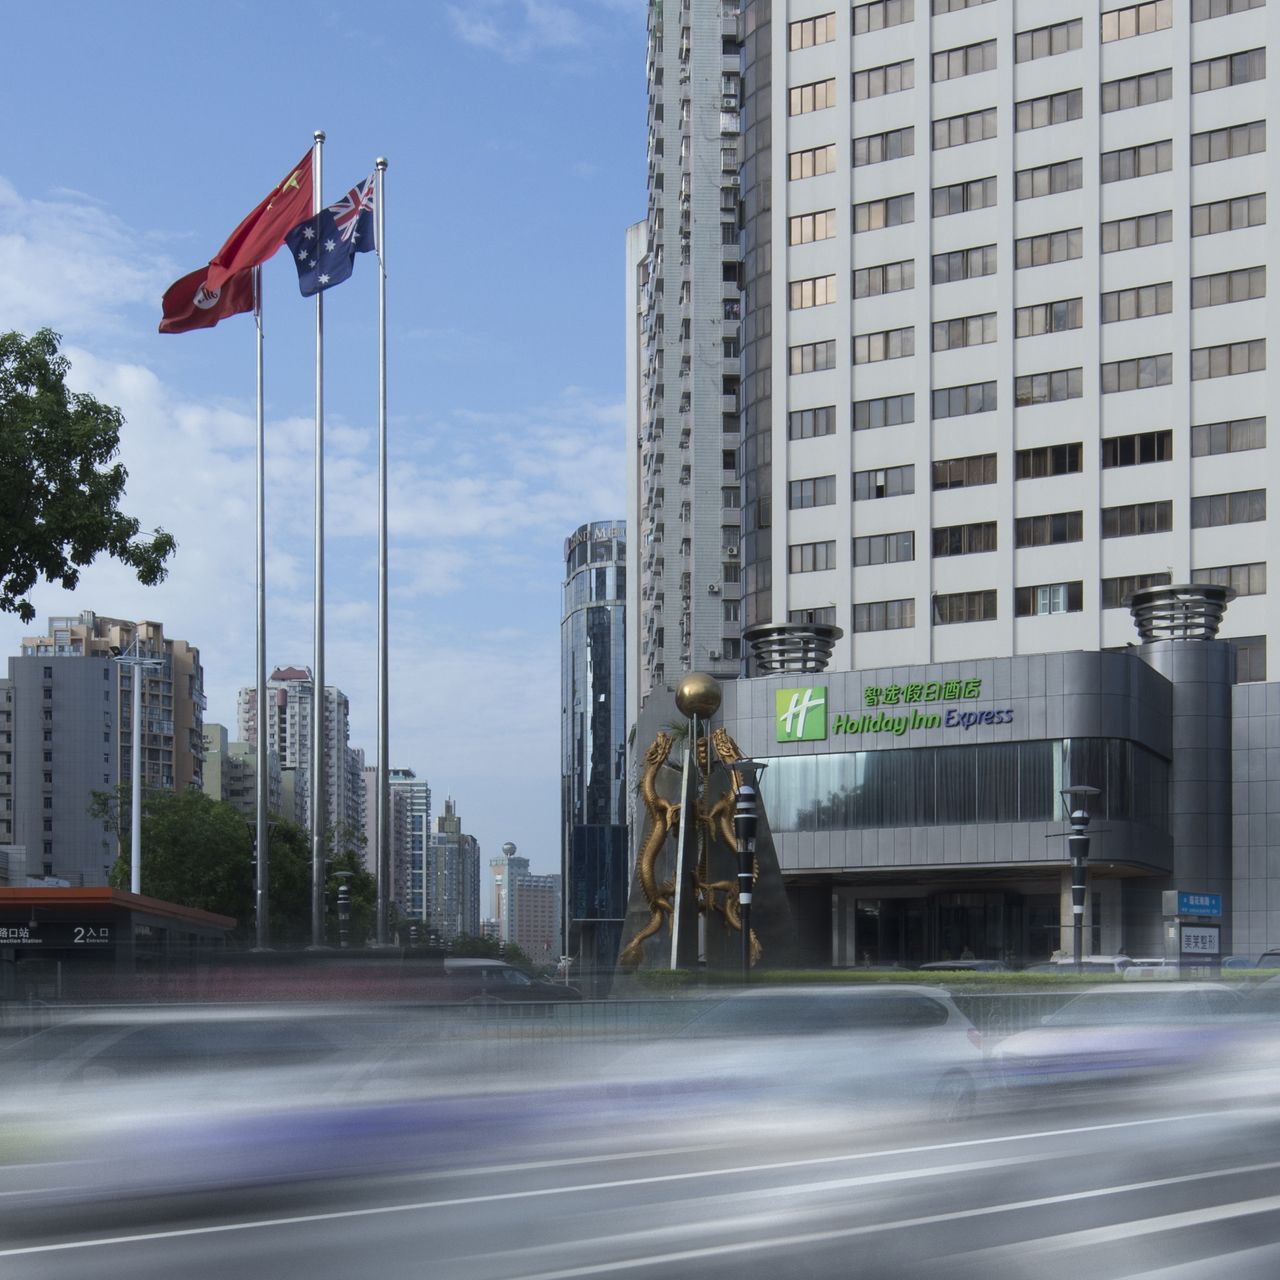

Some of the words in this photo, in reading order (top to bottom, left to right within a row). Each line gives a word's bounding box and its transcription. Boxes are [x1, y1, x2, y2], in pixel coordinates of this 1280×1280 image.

[864, 677, 982, 707] 智选假日酒店
[832, 710, 908, 736] Holiday
[910, 708, 942, 729] Inn
[945, 708, 1014, 731] Express
[73, 927, 86, 944] 2
[86, 927, 109, 938] 入口
